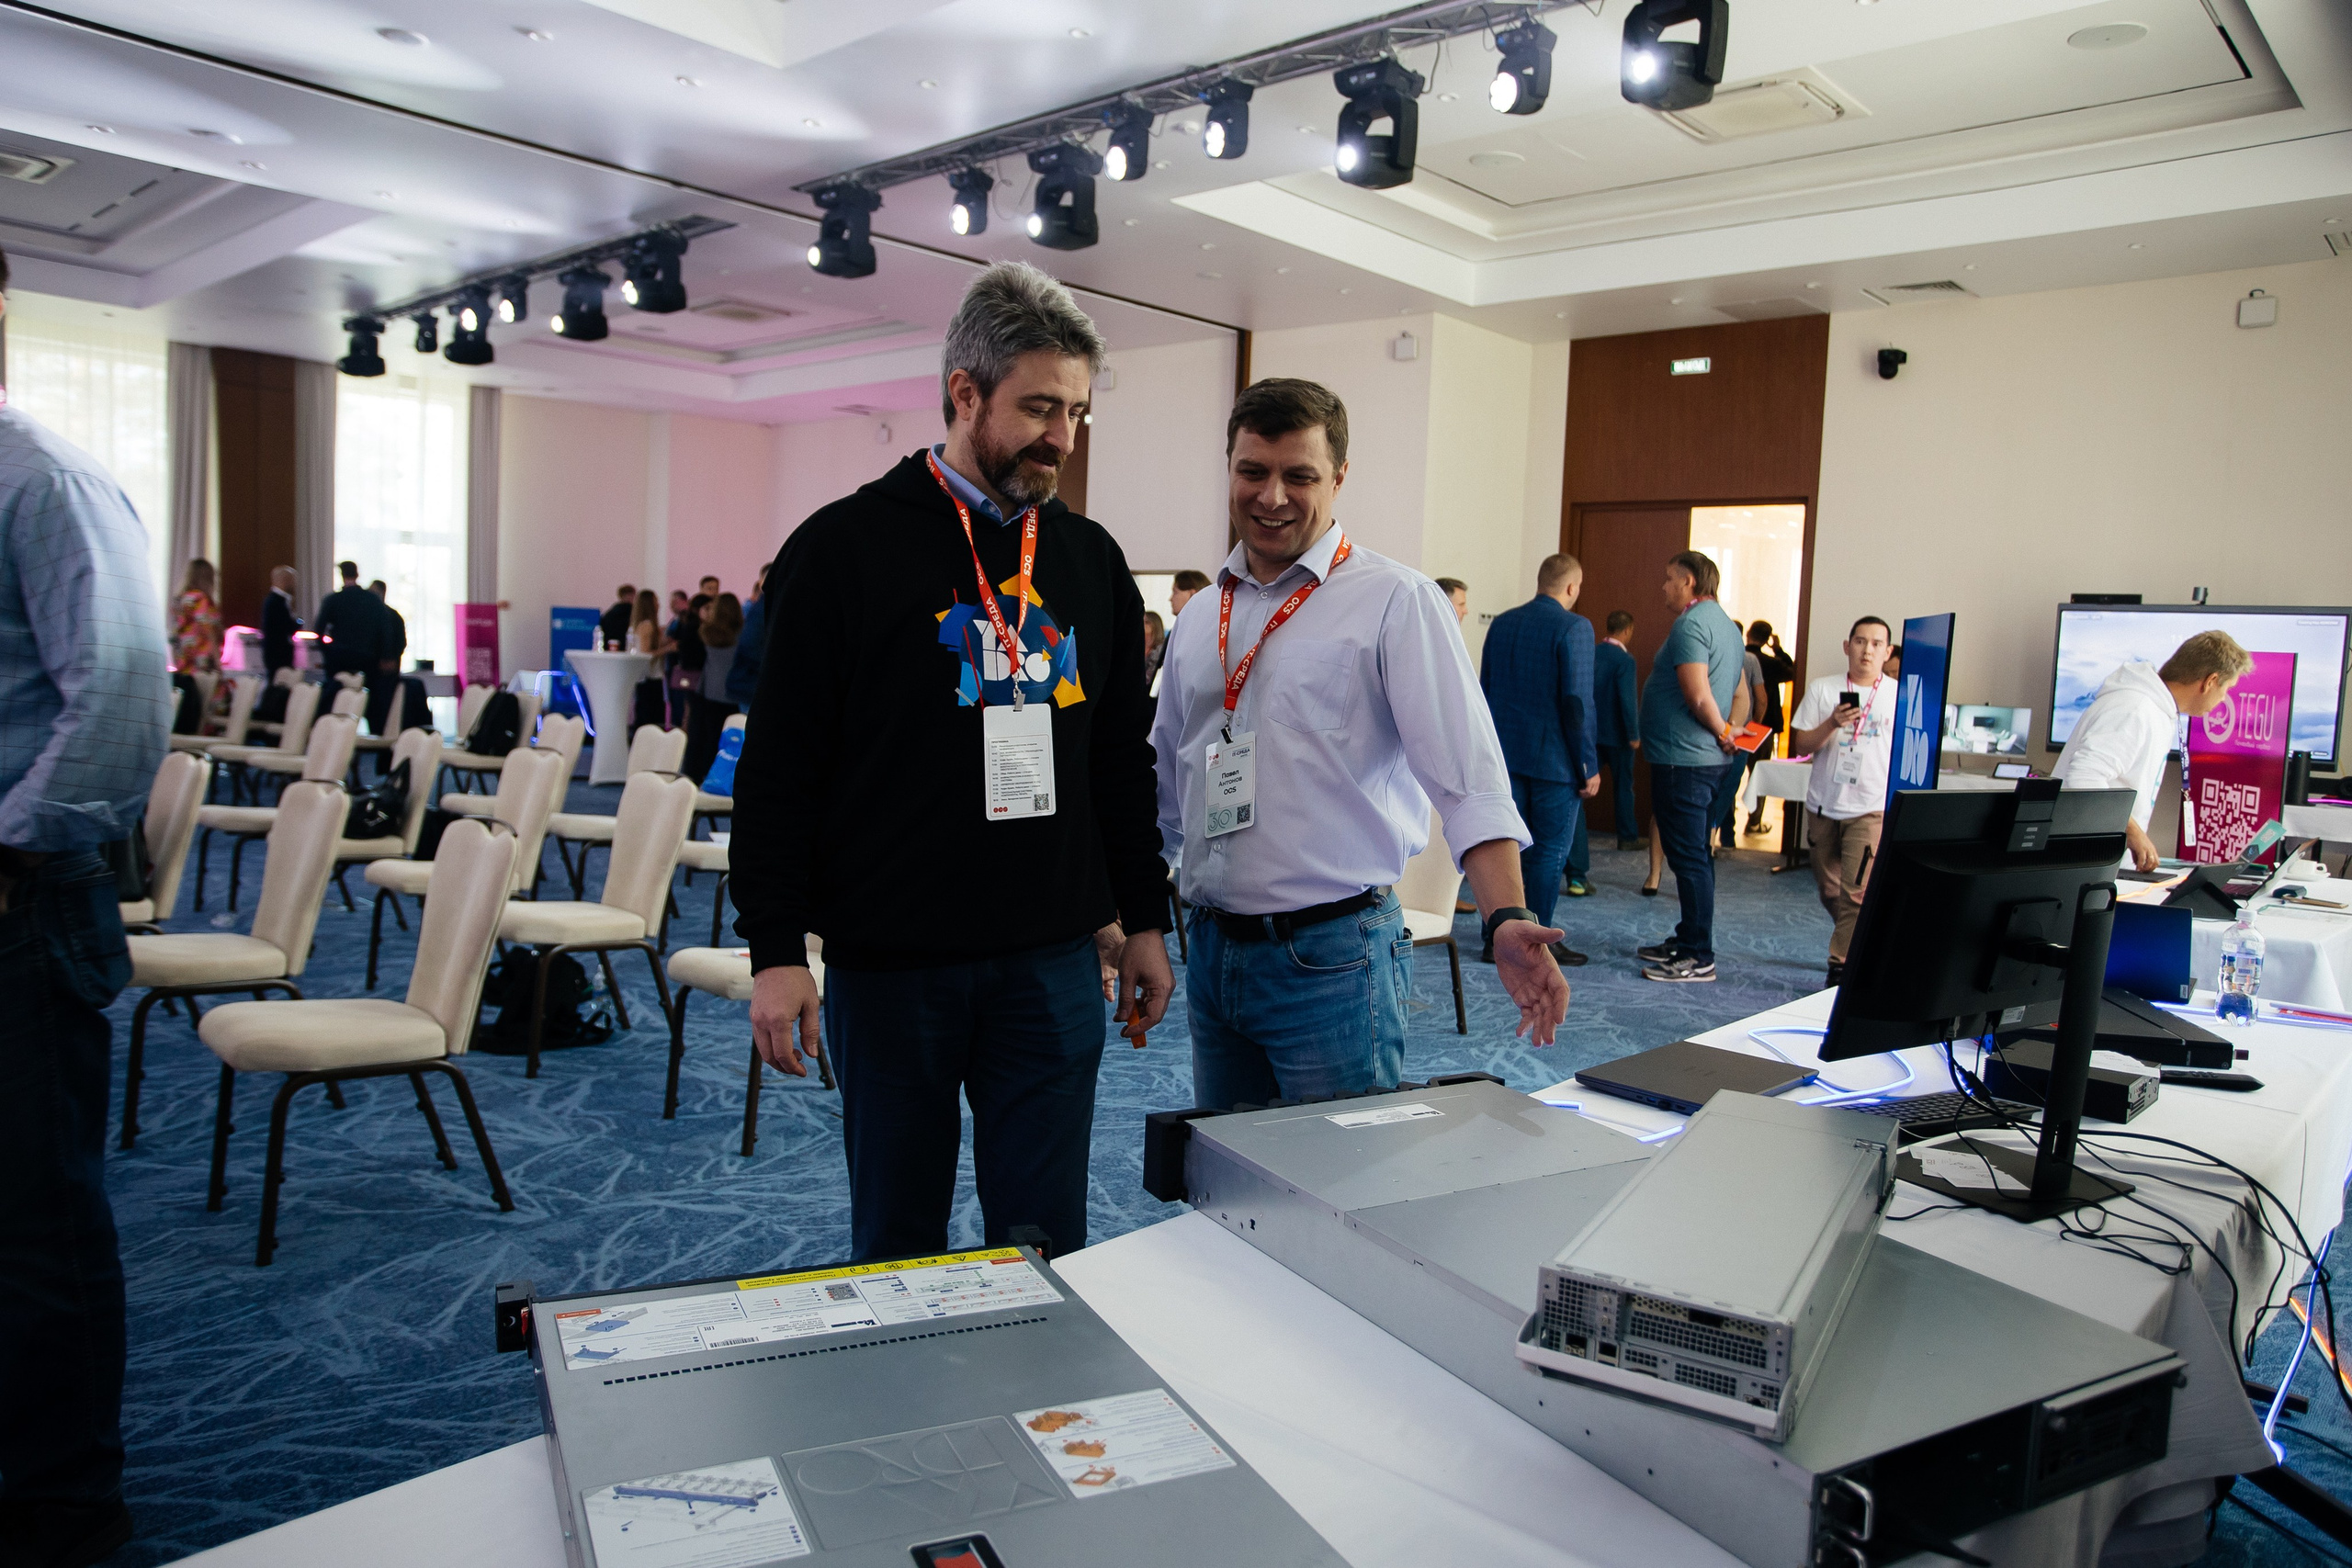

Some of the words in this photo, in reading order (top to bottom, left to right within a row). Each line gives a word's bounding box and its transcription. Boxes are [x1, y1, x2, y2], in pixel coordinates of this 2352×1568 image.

[1023, 554, 1033, 577] OCS
[1283, 596, 1300, 615] OCS
[986, 596, 1012, 648] IT-СРЕДА
[2238, 693, 2276, 741] TEGU
[1221, 769, 1239, 779] Павел
[1223, 786, 1237, 795] OCS
